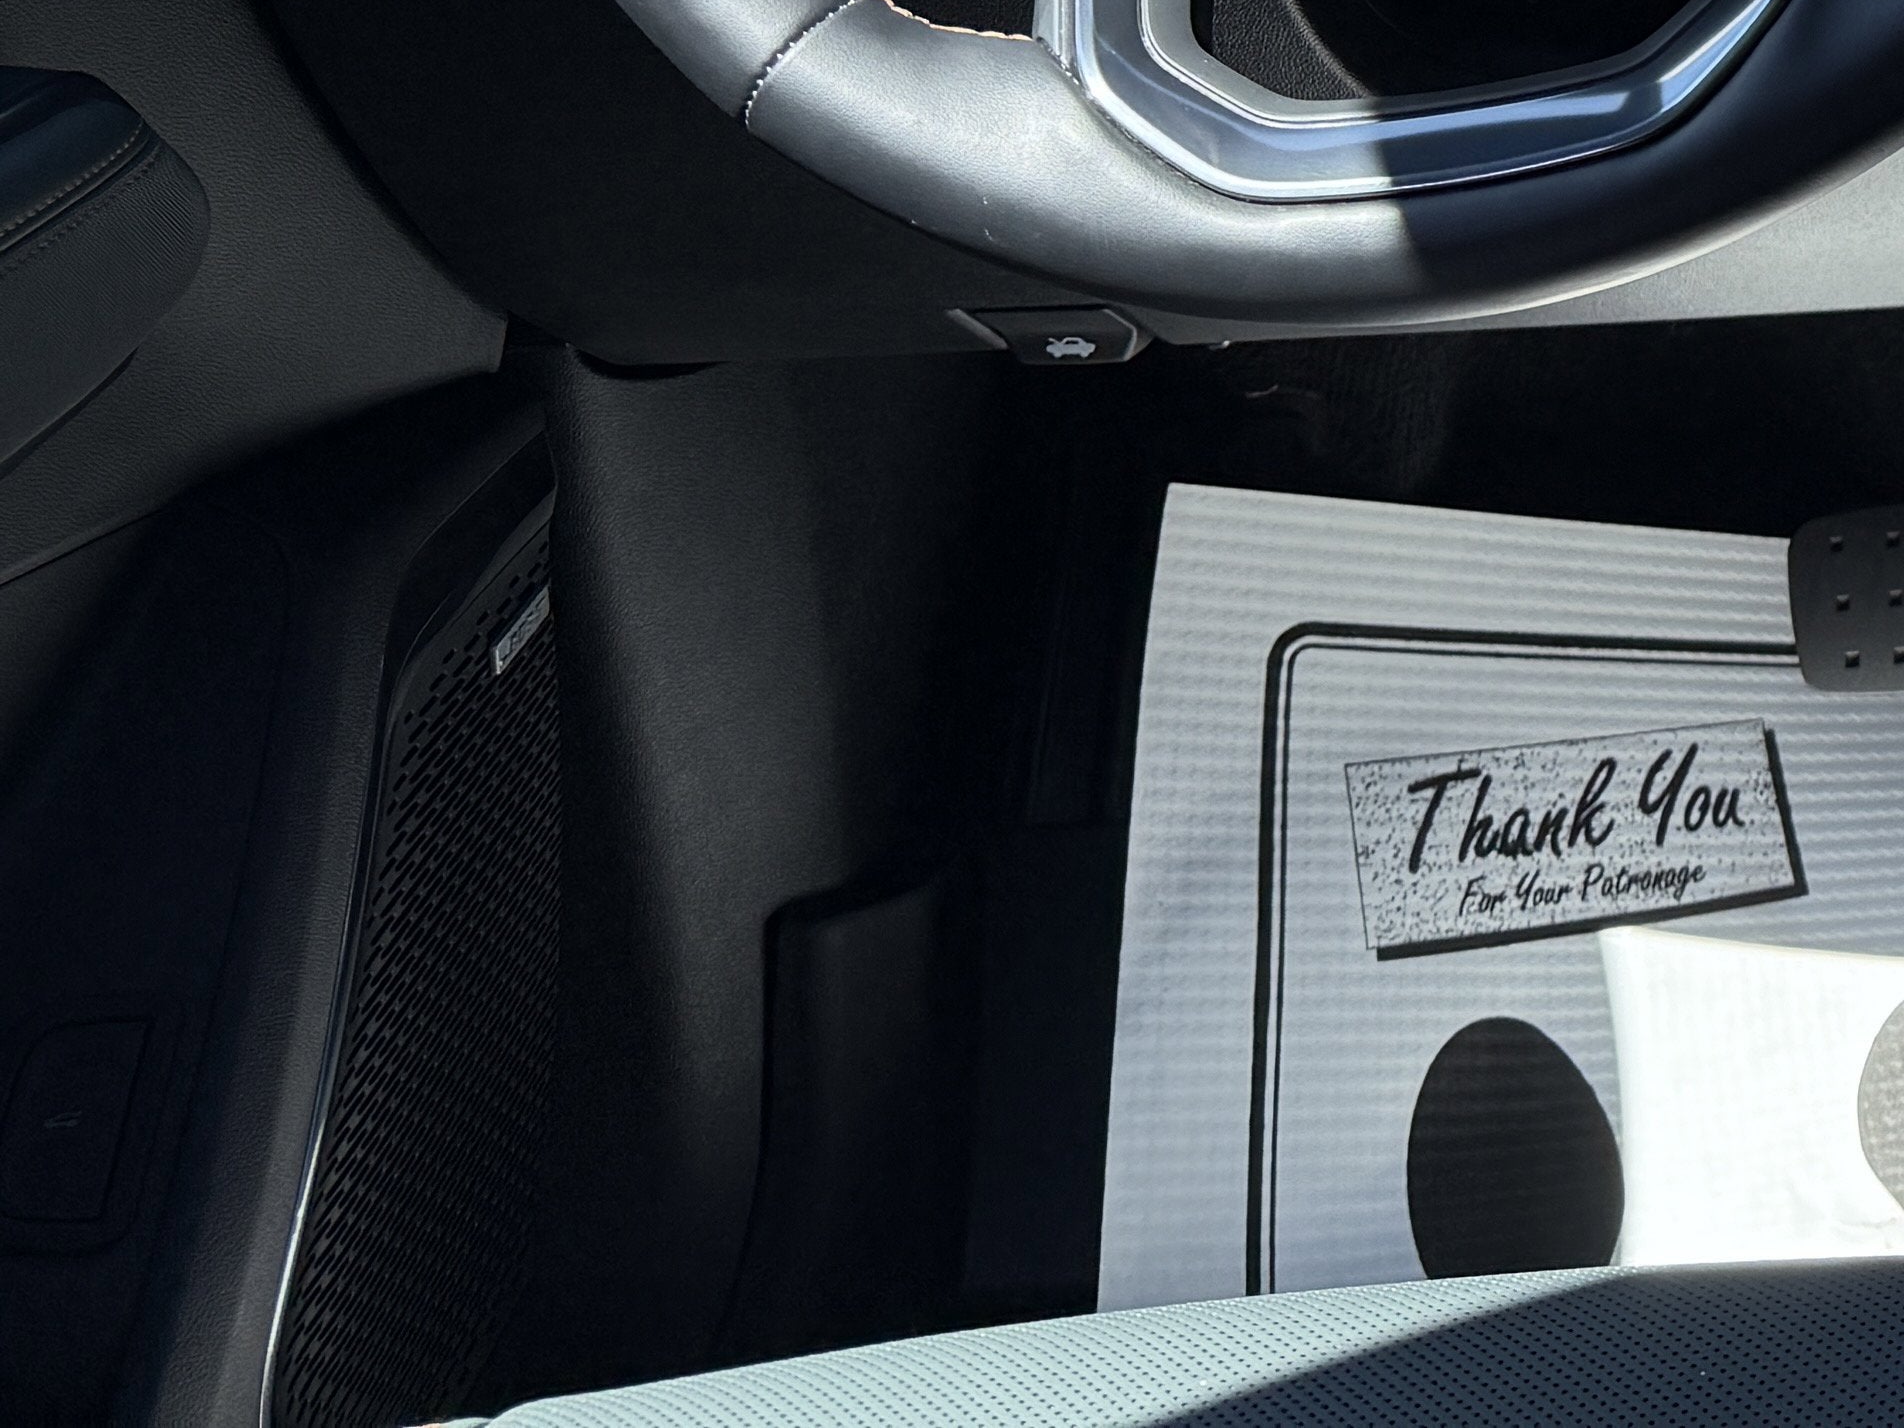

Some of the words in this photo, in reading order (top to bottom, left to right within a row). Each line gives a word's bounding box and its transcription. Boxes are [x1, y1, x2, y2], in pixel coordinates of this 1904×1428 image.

[1407, 757, 1617, 875] Thank
[1638, 743, 1745, 845] You
[1459, 877, 1506, 917] For
[1516, 869, 1570, 912] Your
[1581, 863, 1707, 902] Patronage
